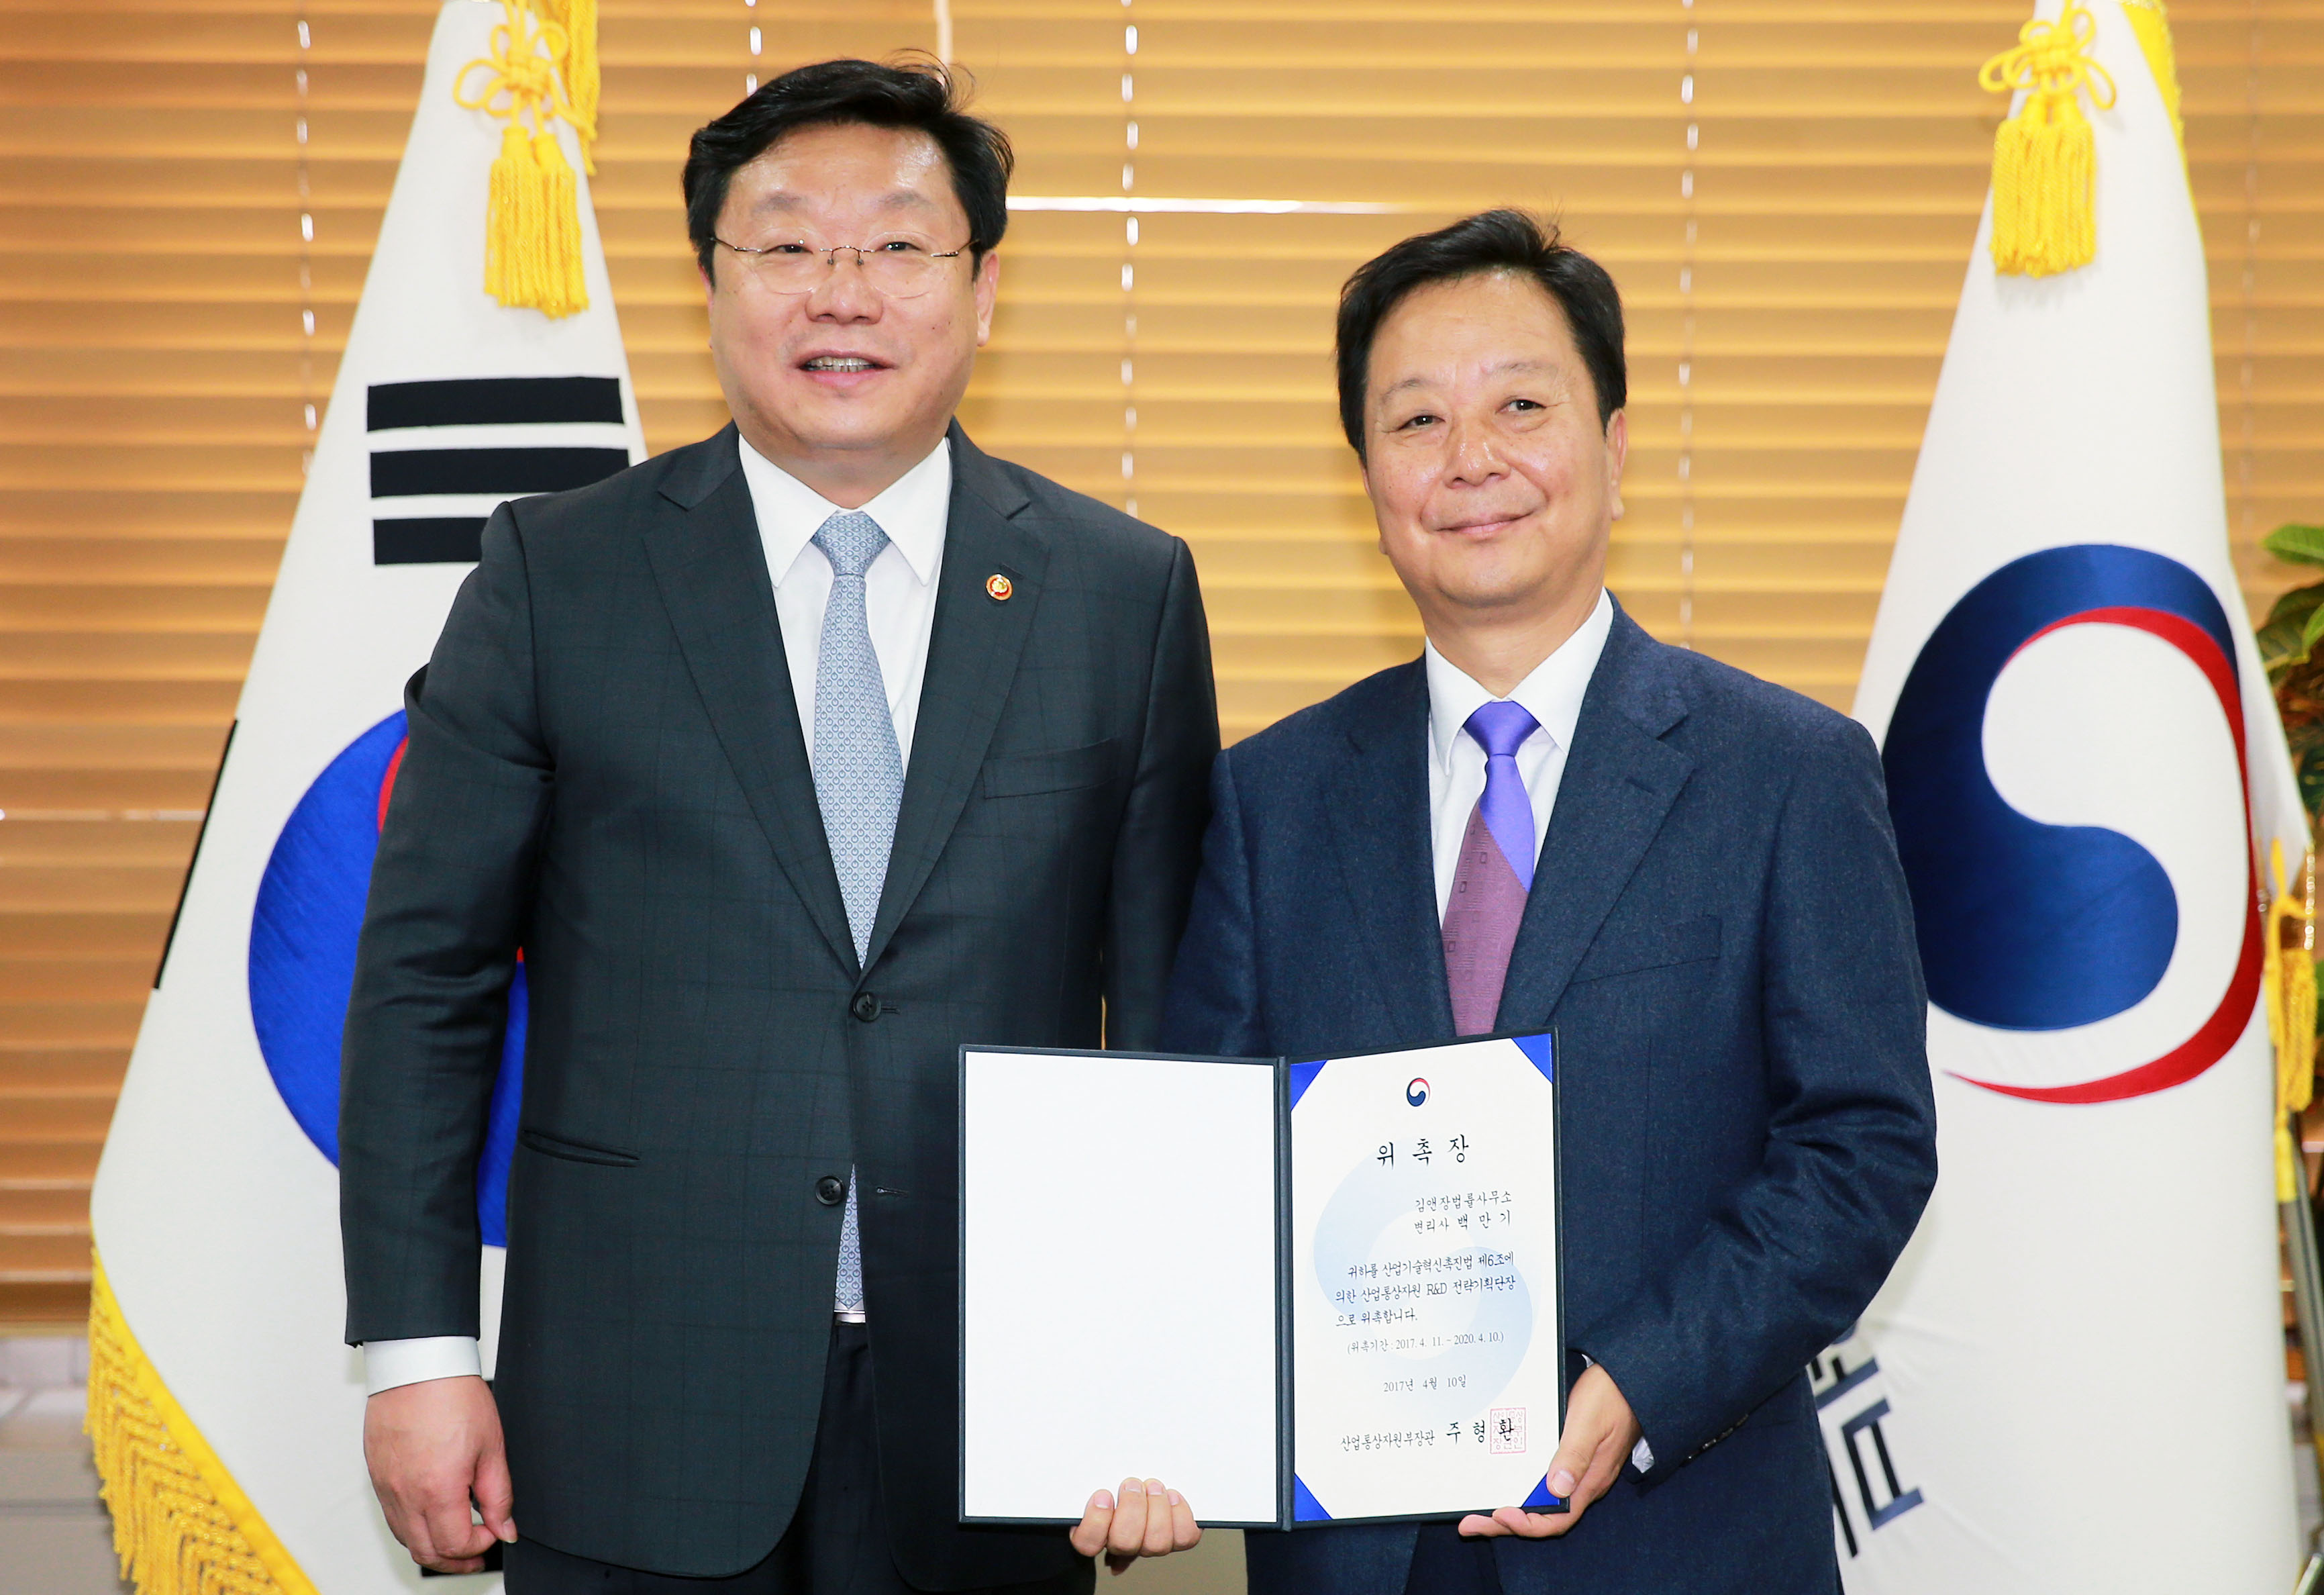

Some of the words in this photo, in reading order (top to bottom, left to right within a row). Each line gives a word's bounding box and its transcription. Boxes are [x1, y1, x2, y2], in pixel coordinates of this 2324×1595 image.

[1414, 1217, 1449, 1235] 변리사
[1348, 1265, 1378, 1279] 귀하를
[1478, 1251, 1513, 1267] 제6조에
[1335, 1289, 1356, 1304] 의한
[1360, 1283, 1420, 1302] 산업통상자원
[1426, 1283, 1447, 1296] R&D
[1453, 1275, 1516, 1294] 전략기획단장
[1335, 1314, 1356, 1326] 으로
[1361, 1308, 1417, 1324] 위촉합니다.
[1384, 1378, 1413, 1392] 2017년
[1423, 1377, 1437, 1390] 4월
[1448, 1375, 1466, 1388] 10일
[1341, 1430, 1435, 1451] 산업통상자원부장관
